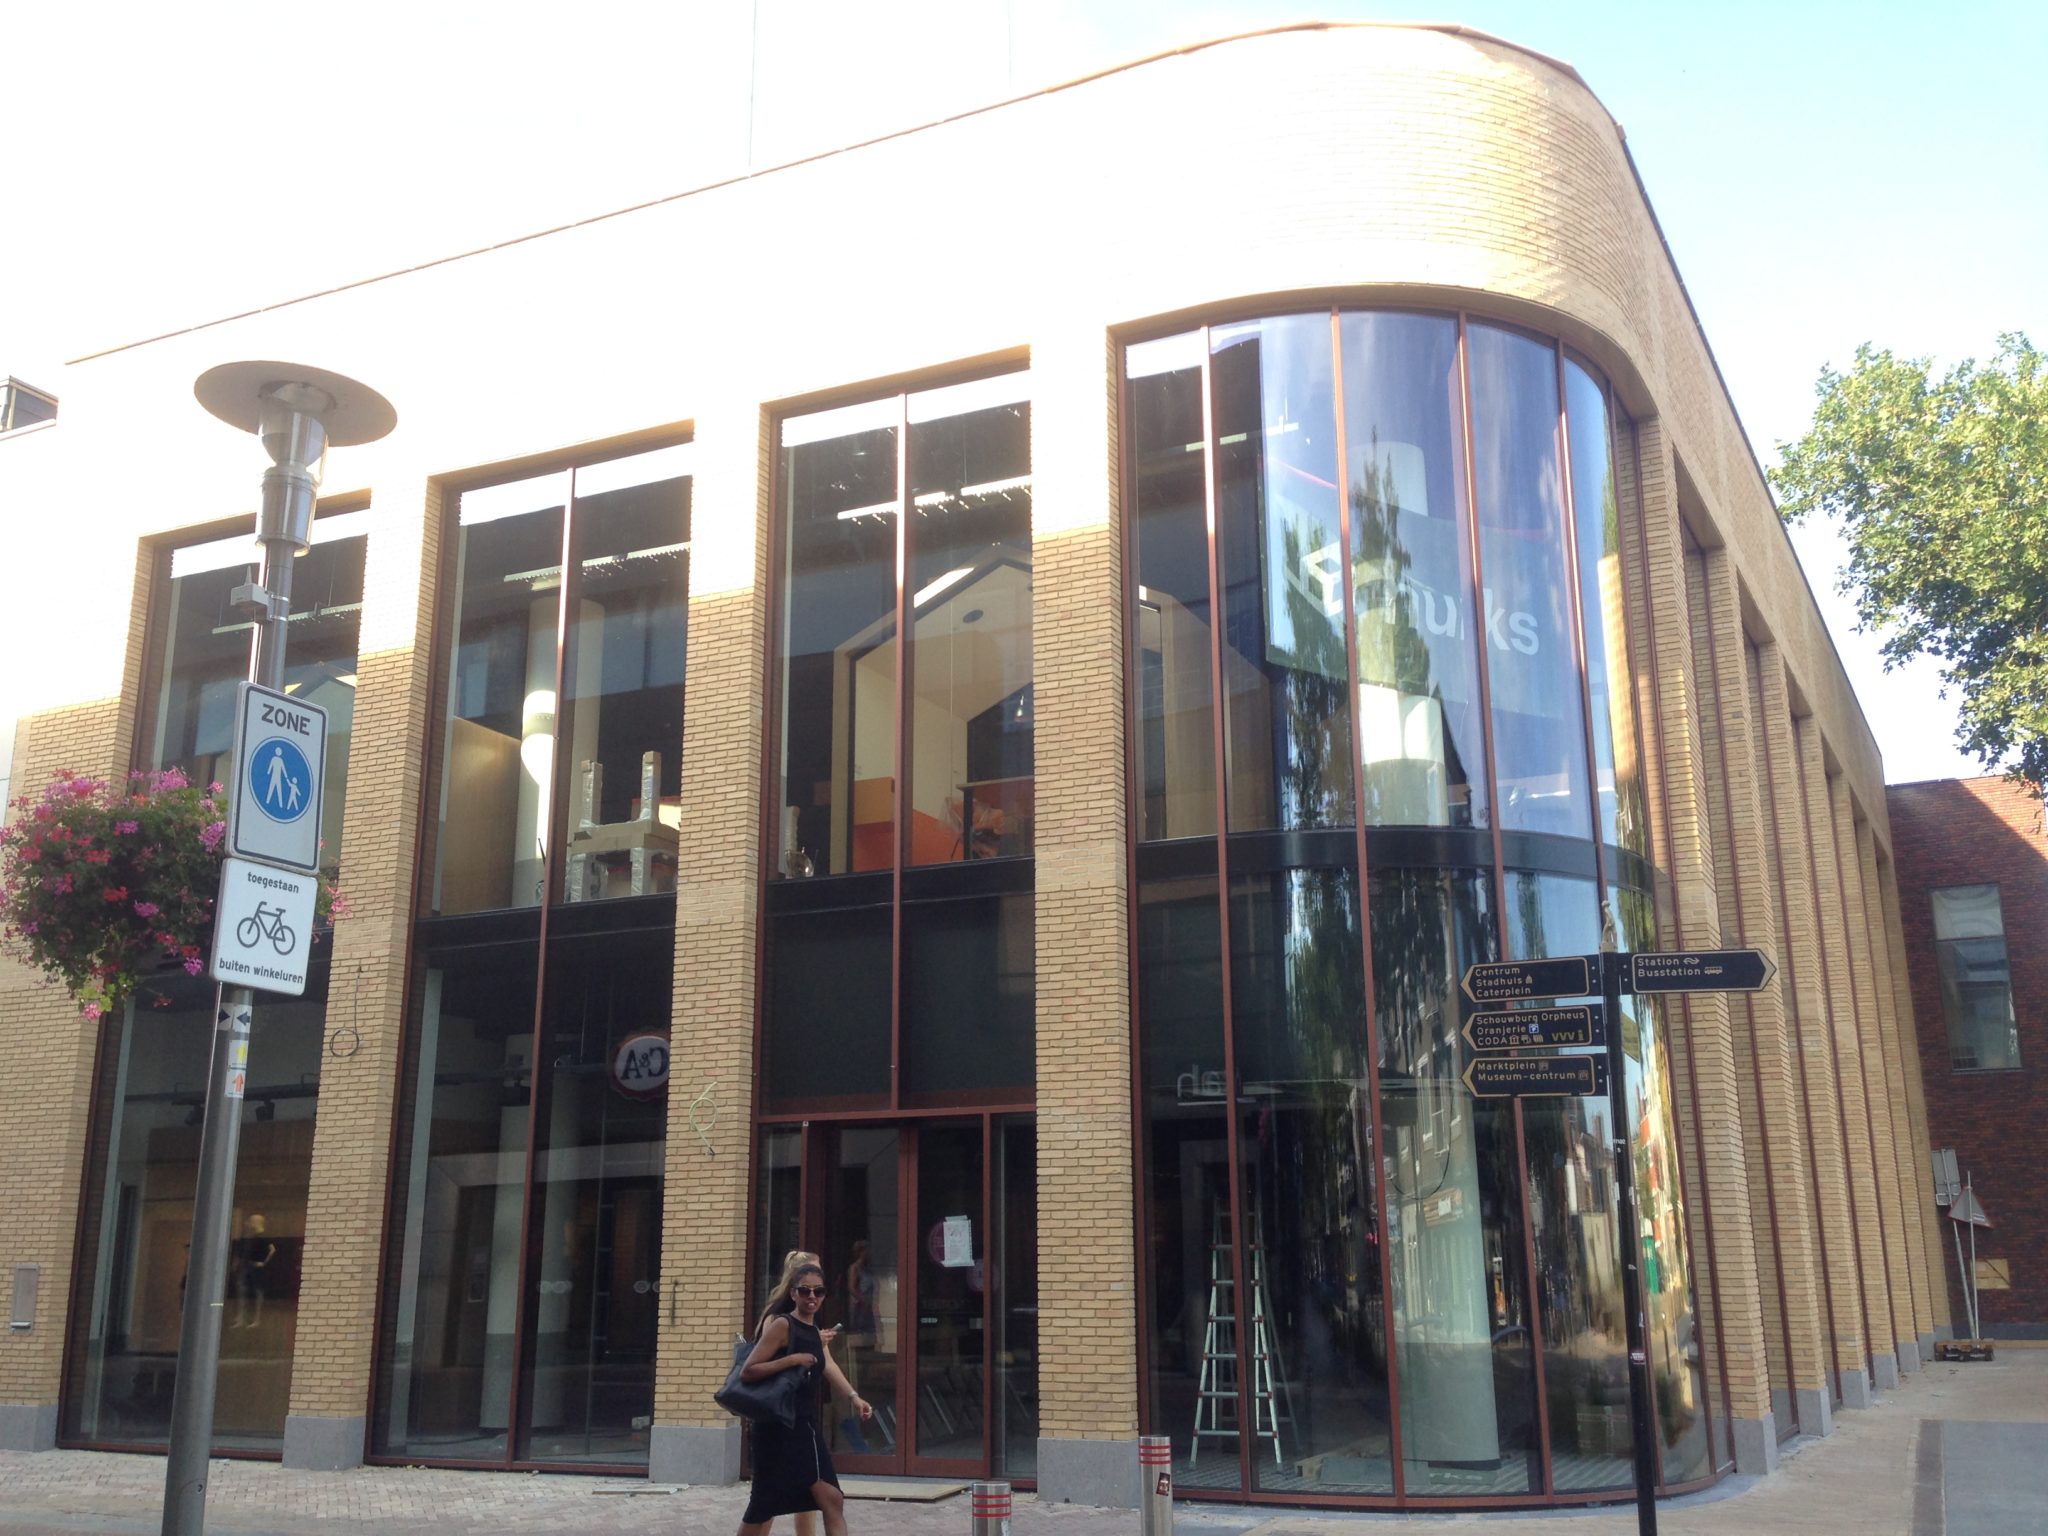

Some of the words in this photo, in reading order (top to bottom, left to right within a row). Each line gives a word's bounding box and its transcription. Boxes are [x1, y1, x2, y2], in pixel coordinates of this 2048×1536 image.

[261, 703, 310, 736] ZONE
[247, 871, 299, 894] toegestaan
[1637, 957, 1680, 967] Station
[219, 958, 250, 974] buiten
[253, 965, 303, 984] winkeluren
[1475, 967, 1520, 977] Centrum
[1637, 967, 1701, 977] Busstation
[1476, 976, 1523, 987] Stadhuis
[1476, 986, 1531, 998] Caterplein
[1476, 1013, 1538, 1025] Schouwburg
[1541, 1011, 1585, 1022] Orpheus
[1477, 1025, 1526, 1036] Oranjerie
[1477, 1035, 1508, 1046] CODA
[1477, 1062, 1536, 1072] Marktplein
[1478, 1071, 1576, 1081] Museum-centrum
